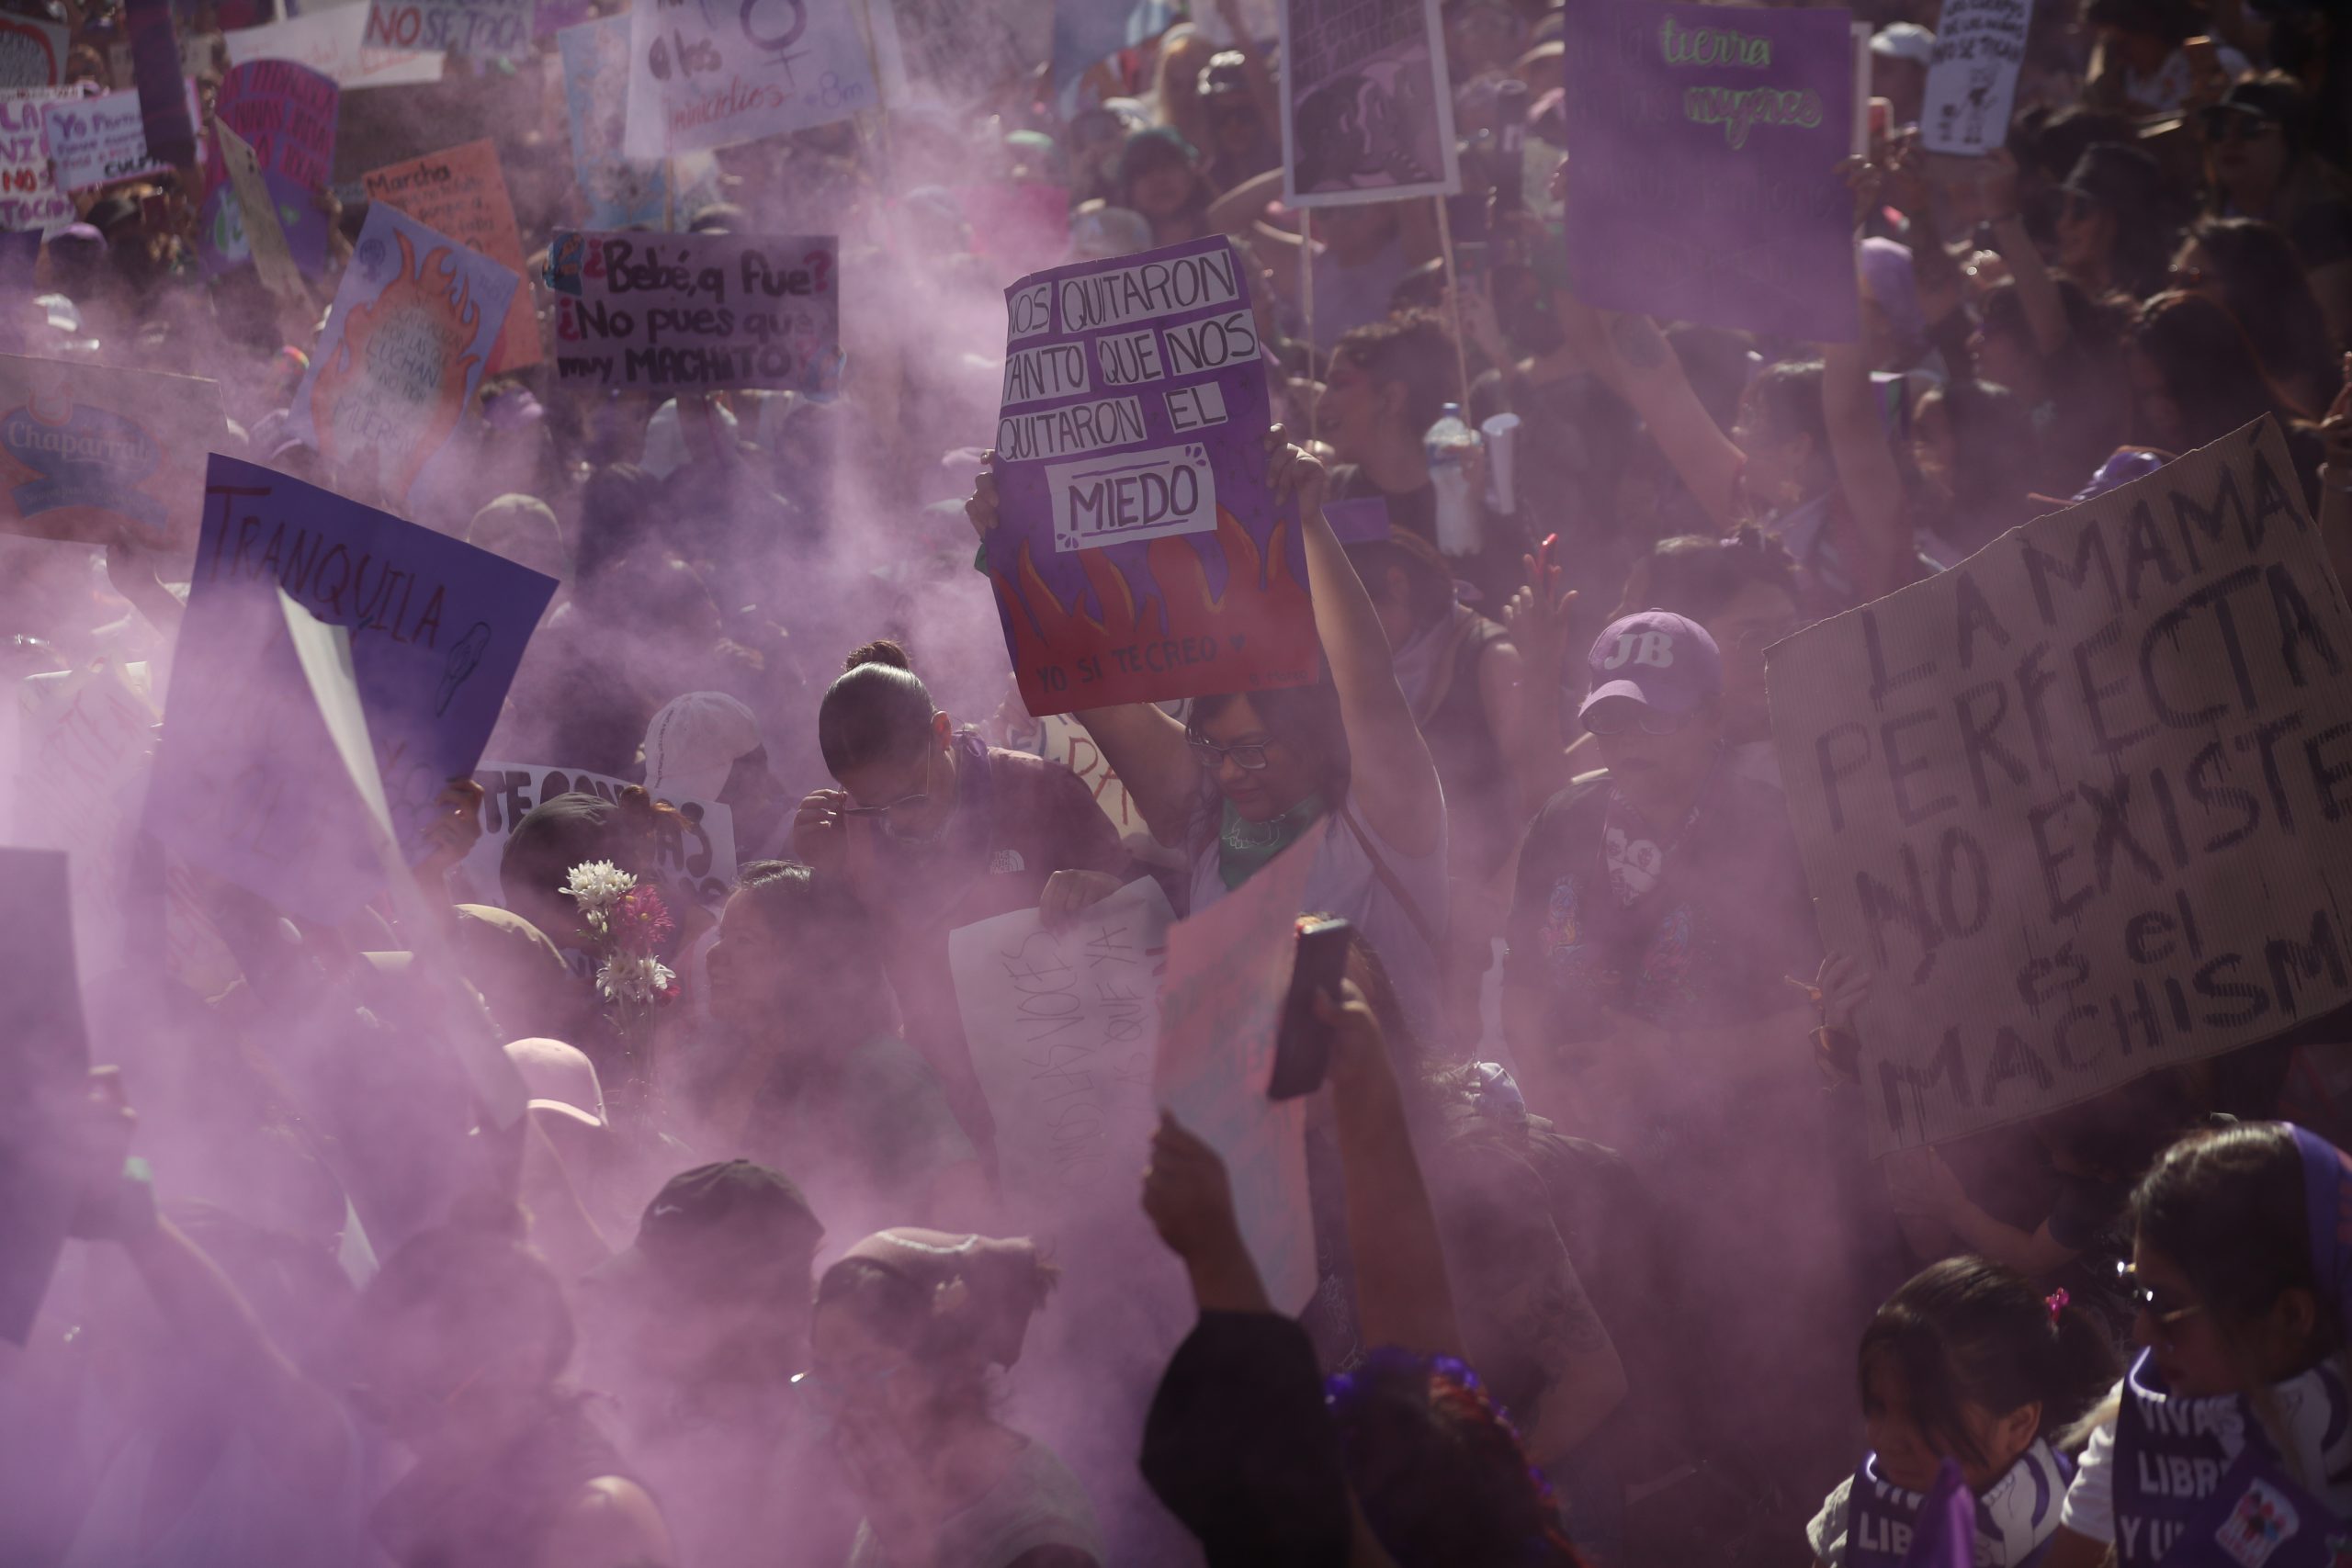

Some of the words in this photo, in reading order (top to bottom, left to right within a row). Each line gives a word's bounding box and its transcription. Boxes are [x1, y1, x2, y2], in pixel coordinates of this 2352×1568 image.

[368, 6, 422, 46] NO
[426, 7, 458, 49] SE
[1658, 13, 1771, 69] tierra
[1683, 86, 1823, 151] mujeres
[367, 161, 452, 198] Marcha
[557, 296, 636, 343] ¿No
[647, 307, 735, 344] pues
[1061, 250, 1237, 333] QUITARON
[365, 334, 440, 389] LUCHAN
[1005, 344, 1085, 401] ANTO
[1099, 333, 1163, 385] QUE
[1166, 312, 1256, 374] NOS
[998, 399, 1145, 461] QUITARON
[1164, 386, 1227, 432] EL
[1068, 464, 1200, 532] MIEDO
[206, 485, 447, 649] TRANQUILA
[1036, 666, 1068, 694] YO
[1077, 655, 1102, 684] SI
[1108, 644, 1144, 674] TE
[1147, 634, 1218, 673] CREO
[1603, 630, 1675, 672] JB
[1861, 570, 2011, 714] LA
[1814, 560, 2342, 829] PERFECTA
[472, 769, 533, 835] TE
[1856, 829, 1994, 987] NO
[2028, 709, 2352, 923] EXISTE
[1083, 924, 1138, 970] YA
[2125, 887, 2202, 965] el
